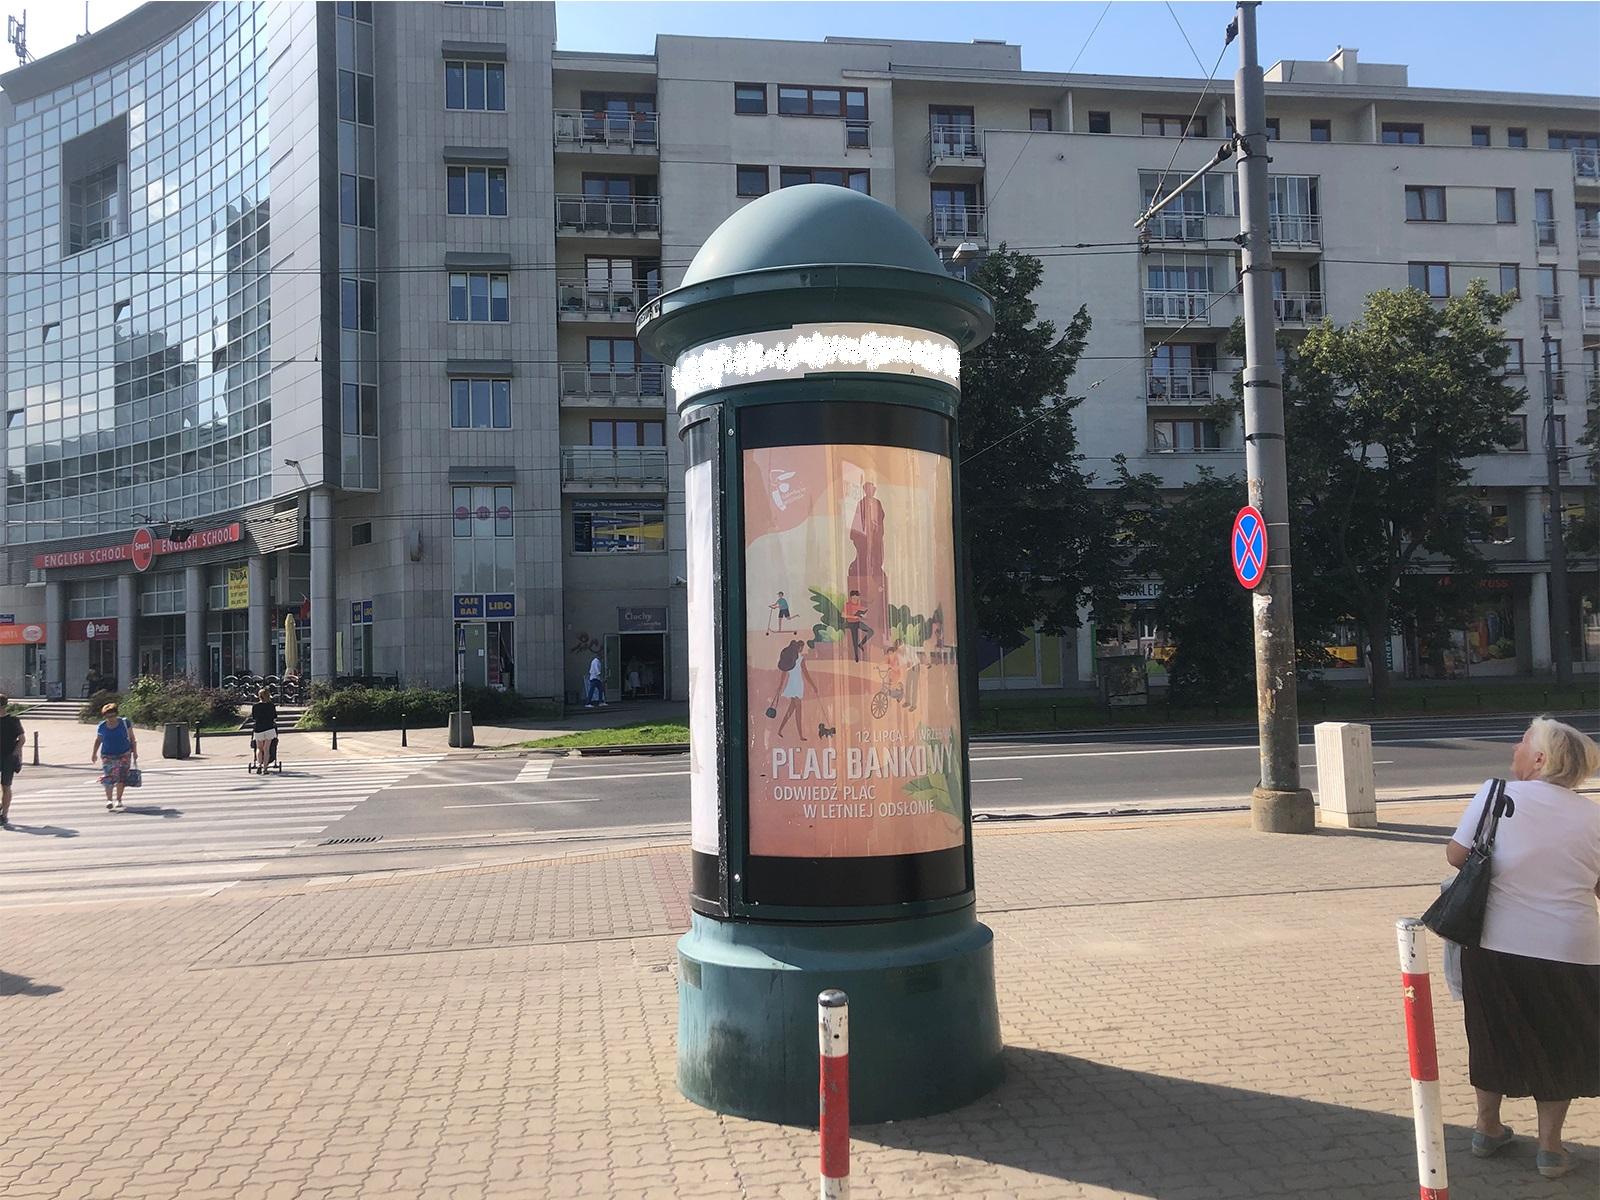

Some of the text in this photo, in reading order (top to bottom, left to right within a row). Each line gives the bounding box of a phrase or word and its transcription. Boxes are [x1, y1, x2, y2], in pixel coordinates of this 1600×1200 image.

[162, 528, 232, 553] ENGLISH SCHOOL
[44, 552, 85, 567] ENGLISH
[90, 547, 126, 563] SCHOOL
[458, 597, 479, 605] CAFE
[460, 607, 478, 615] BAR
[856, 731, 870, 743] 12
[873, 730, 902, 742] LIPCA
[772, 744, 953, 780] PLAC BANKOWY
[773, 783, 876, 801] ODWIEDŹ PLAC
[803, 800, 935, 819] W LETNIEJ ODSŁONIE
